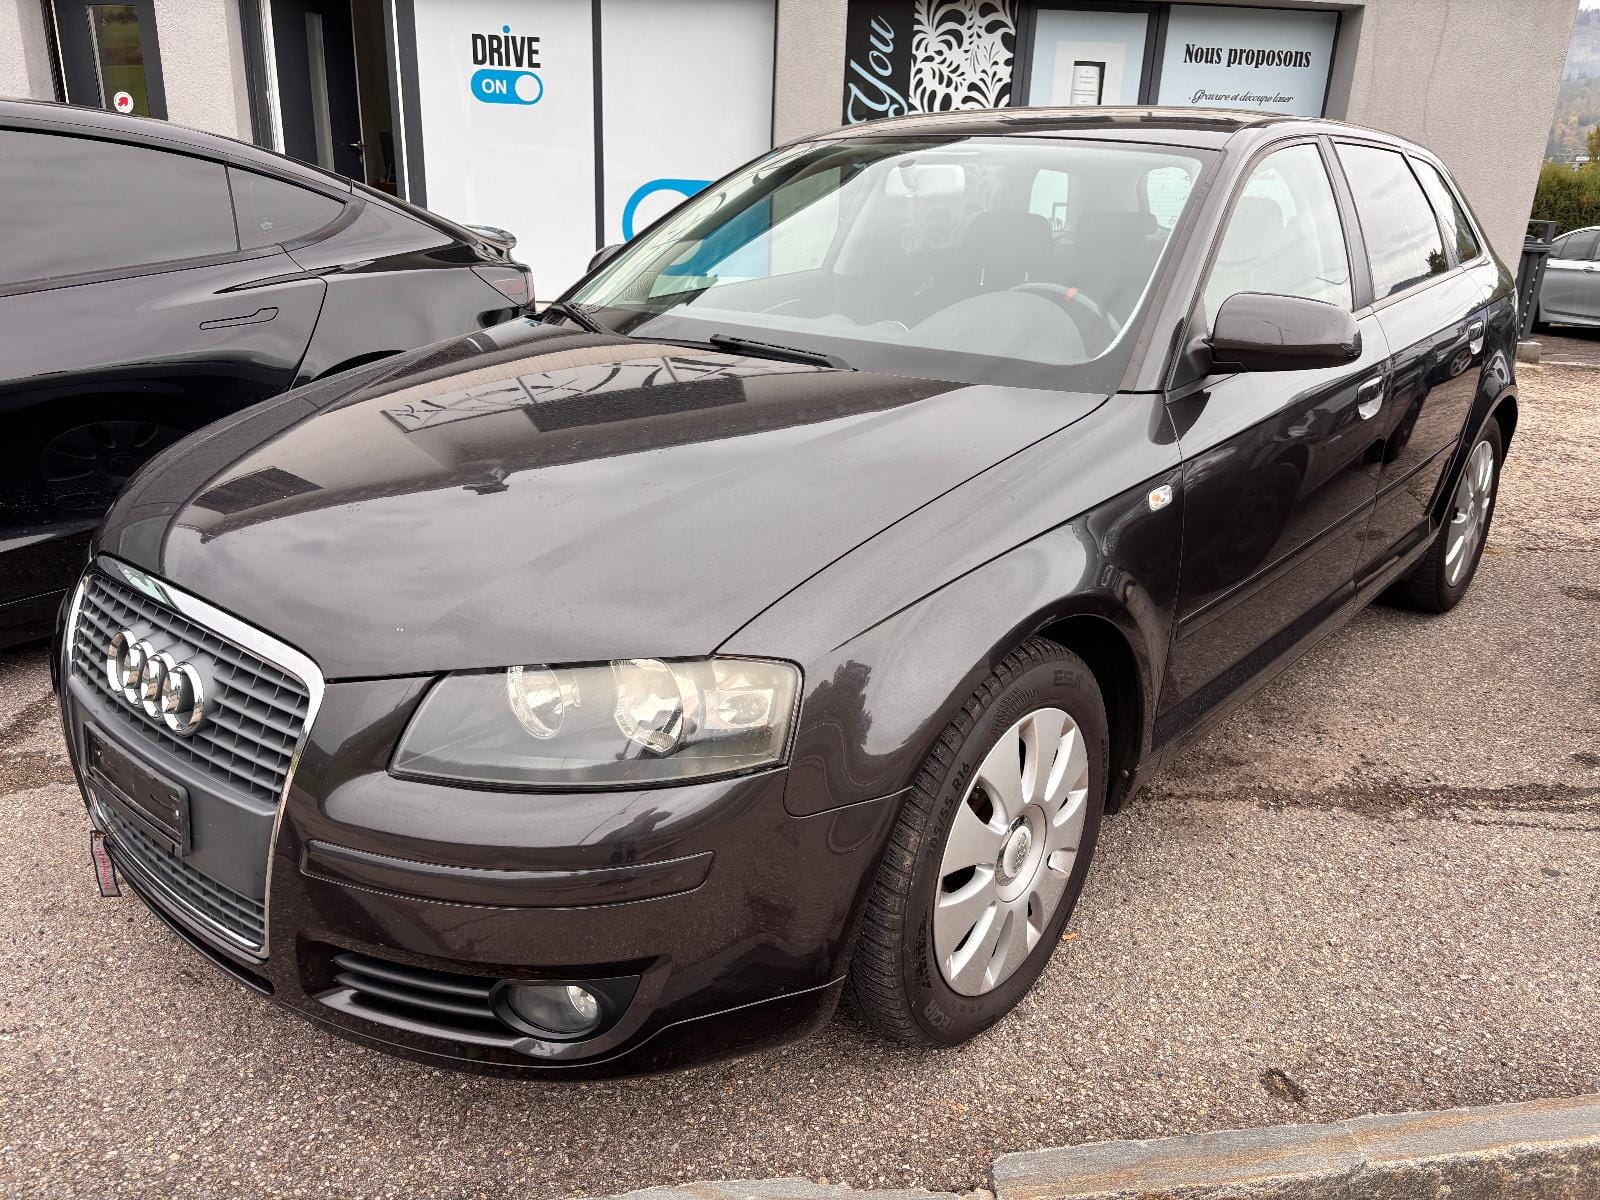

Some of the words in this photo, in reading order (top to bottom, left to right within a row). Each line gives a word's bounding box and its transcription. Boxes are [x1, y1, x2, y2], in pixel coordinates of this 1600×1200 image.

[1183, 43, 1223, 64] Nous
[1226, 47, 1312, 69] proposons
[847, 15, 909, 125] You
[481, 78, 507, 95] ON
[1191, 89, 1231, 104] Gravure
[1230, 93, 1240, 102] et
[1239, 91, 1272, 106] découpe
[1272, 92, 1294, 103] laser
[926, 796, 954, 859] 205/55
[952, 761, 970, 791] R16
